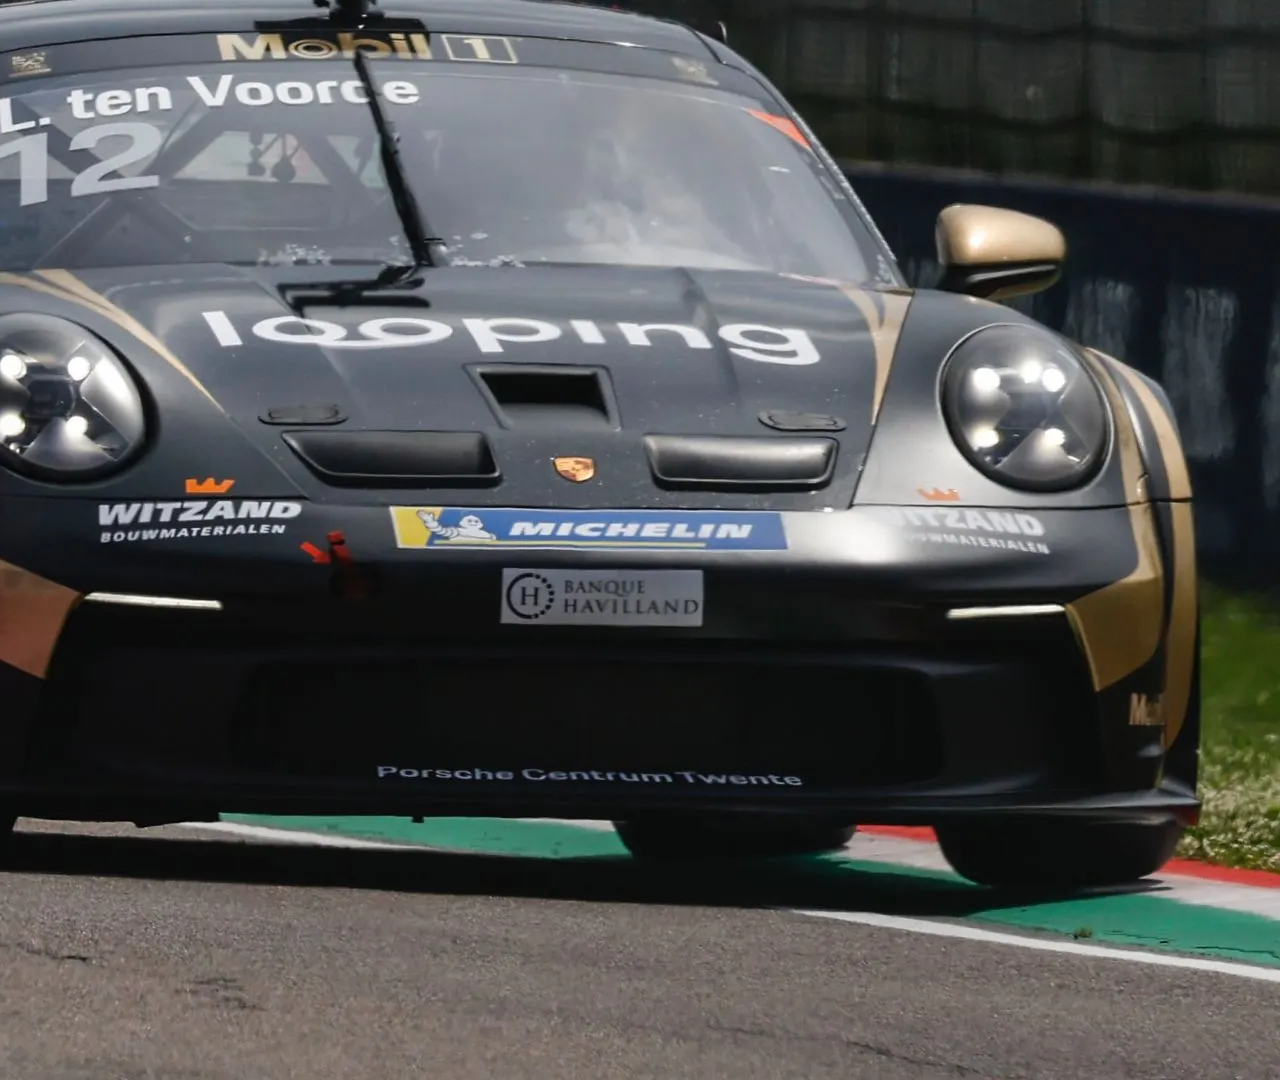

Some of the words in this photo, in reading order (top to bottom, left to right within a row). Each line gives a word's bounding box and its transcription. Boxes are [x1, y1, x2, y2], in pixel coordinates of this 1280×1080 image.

[216, 33, 433, 60] Mobil
[66, 83, 172, 119] ten
[201, 310, 821, 366] looping
[97, 500, 302, 526] WITZAND
[100, 523, 286, 542] BOUWMATERIALEN
[509, 520, 753, 540] MICHELIN
[564, 579, 646, 597] BANQUE
[563, 597, 700, 616] HAVILLAND
[377, 765, 513, 781] Porsche
[523, 768, 672, 784] Centrum
[678, 771, 803, 787] Twente
